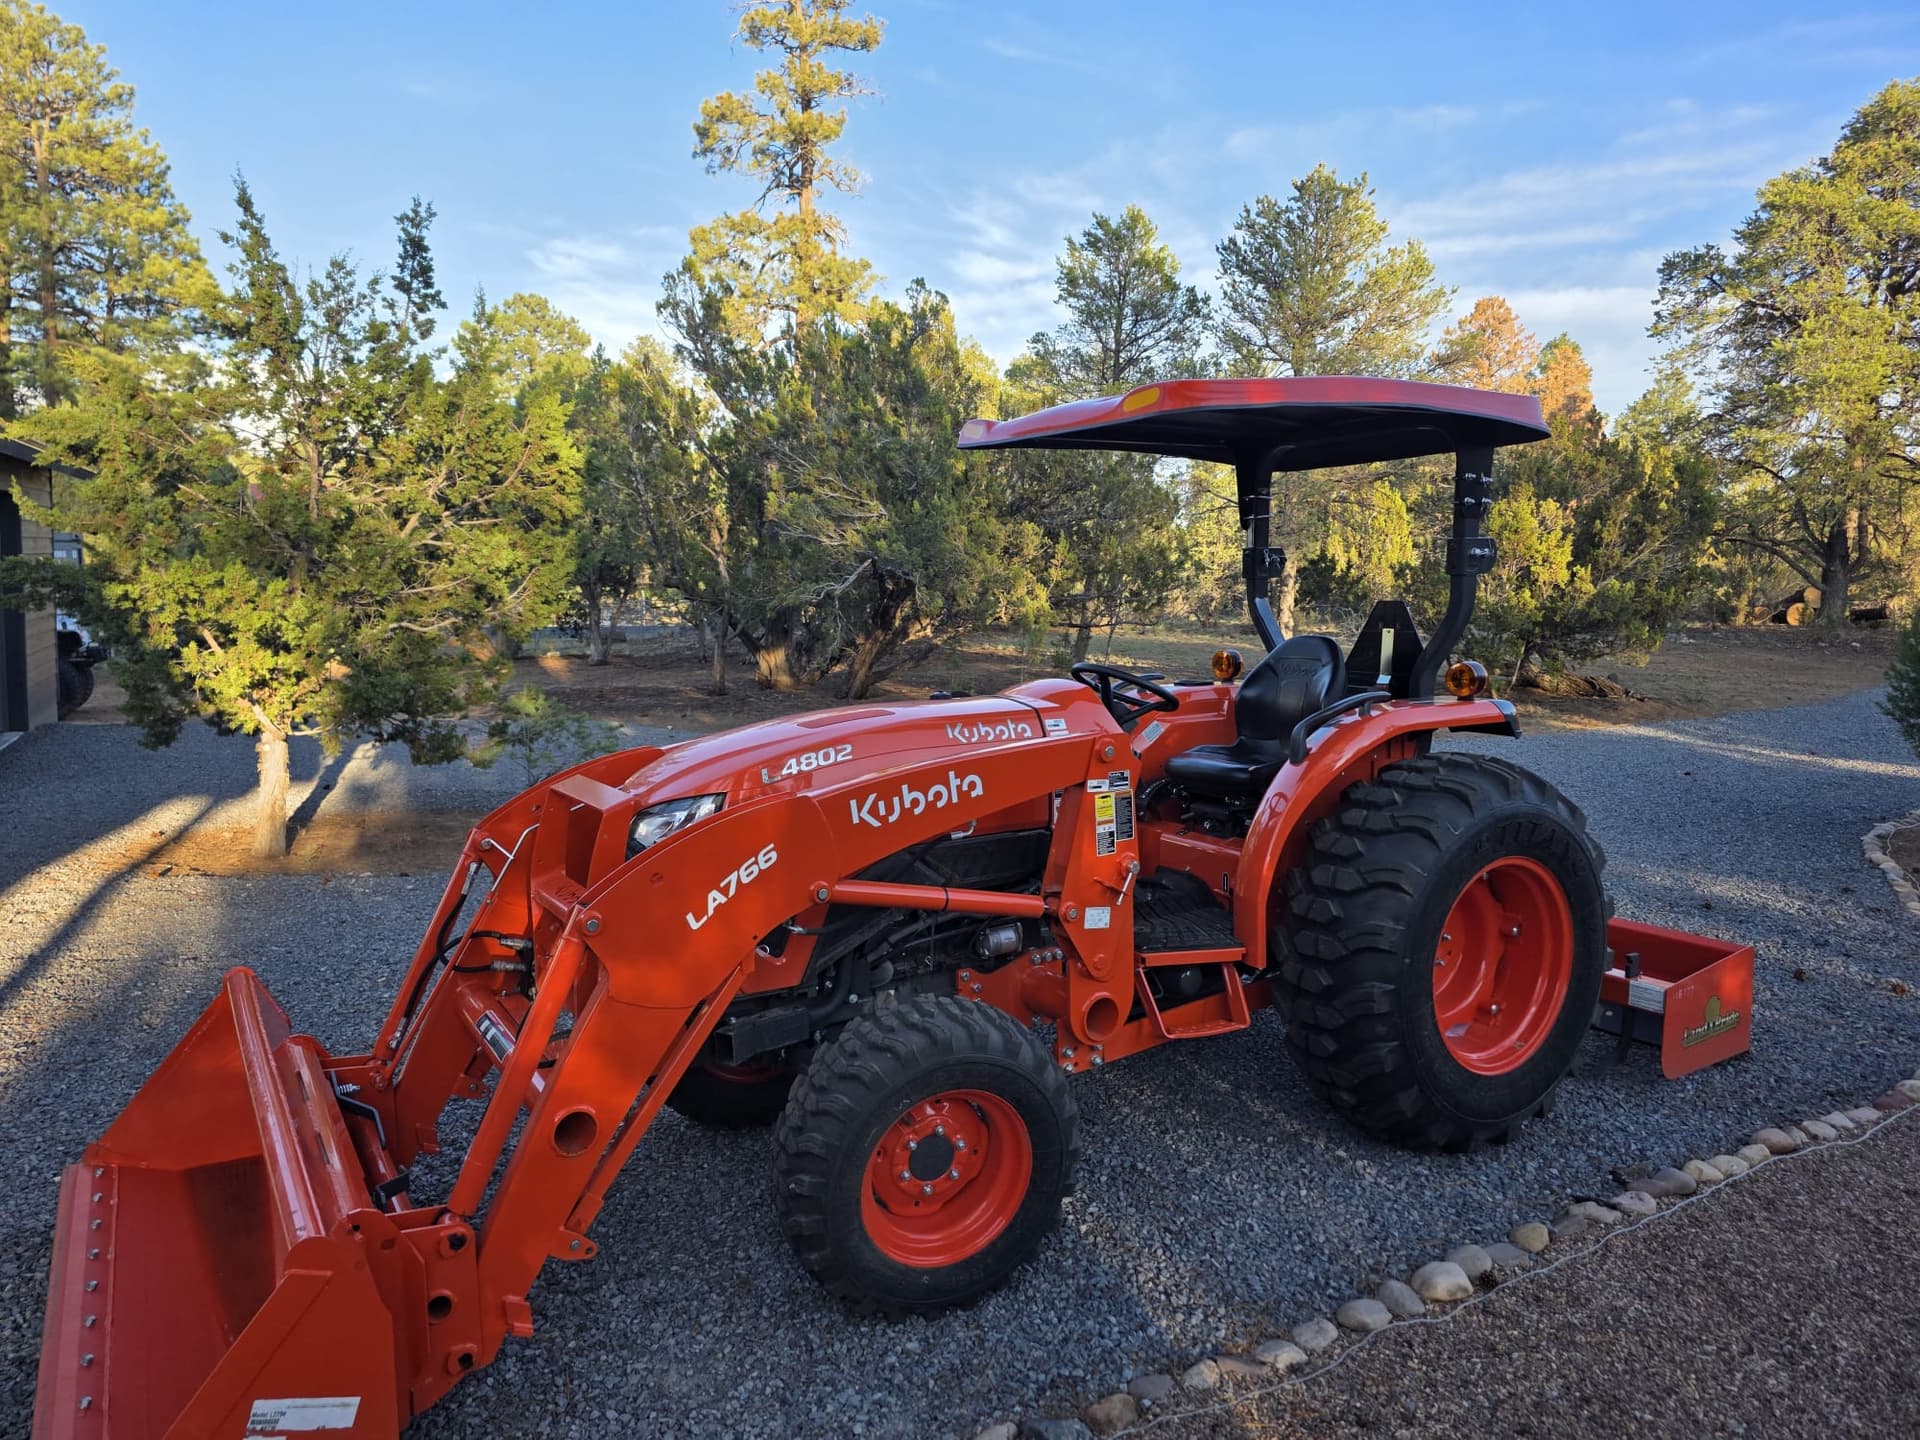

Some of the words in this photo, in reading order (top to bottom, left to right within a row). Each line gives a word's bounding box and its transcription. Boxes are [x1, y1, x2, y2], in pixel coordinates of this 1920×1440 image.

[945, 719, 1033, 744] Kubota
[761, 744, 853, 784] L4802
[849, 770, 985, 828] Kubota
[685, 842, 779, 931] LA766
